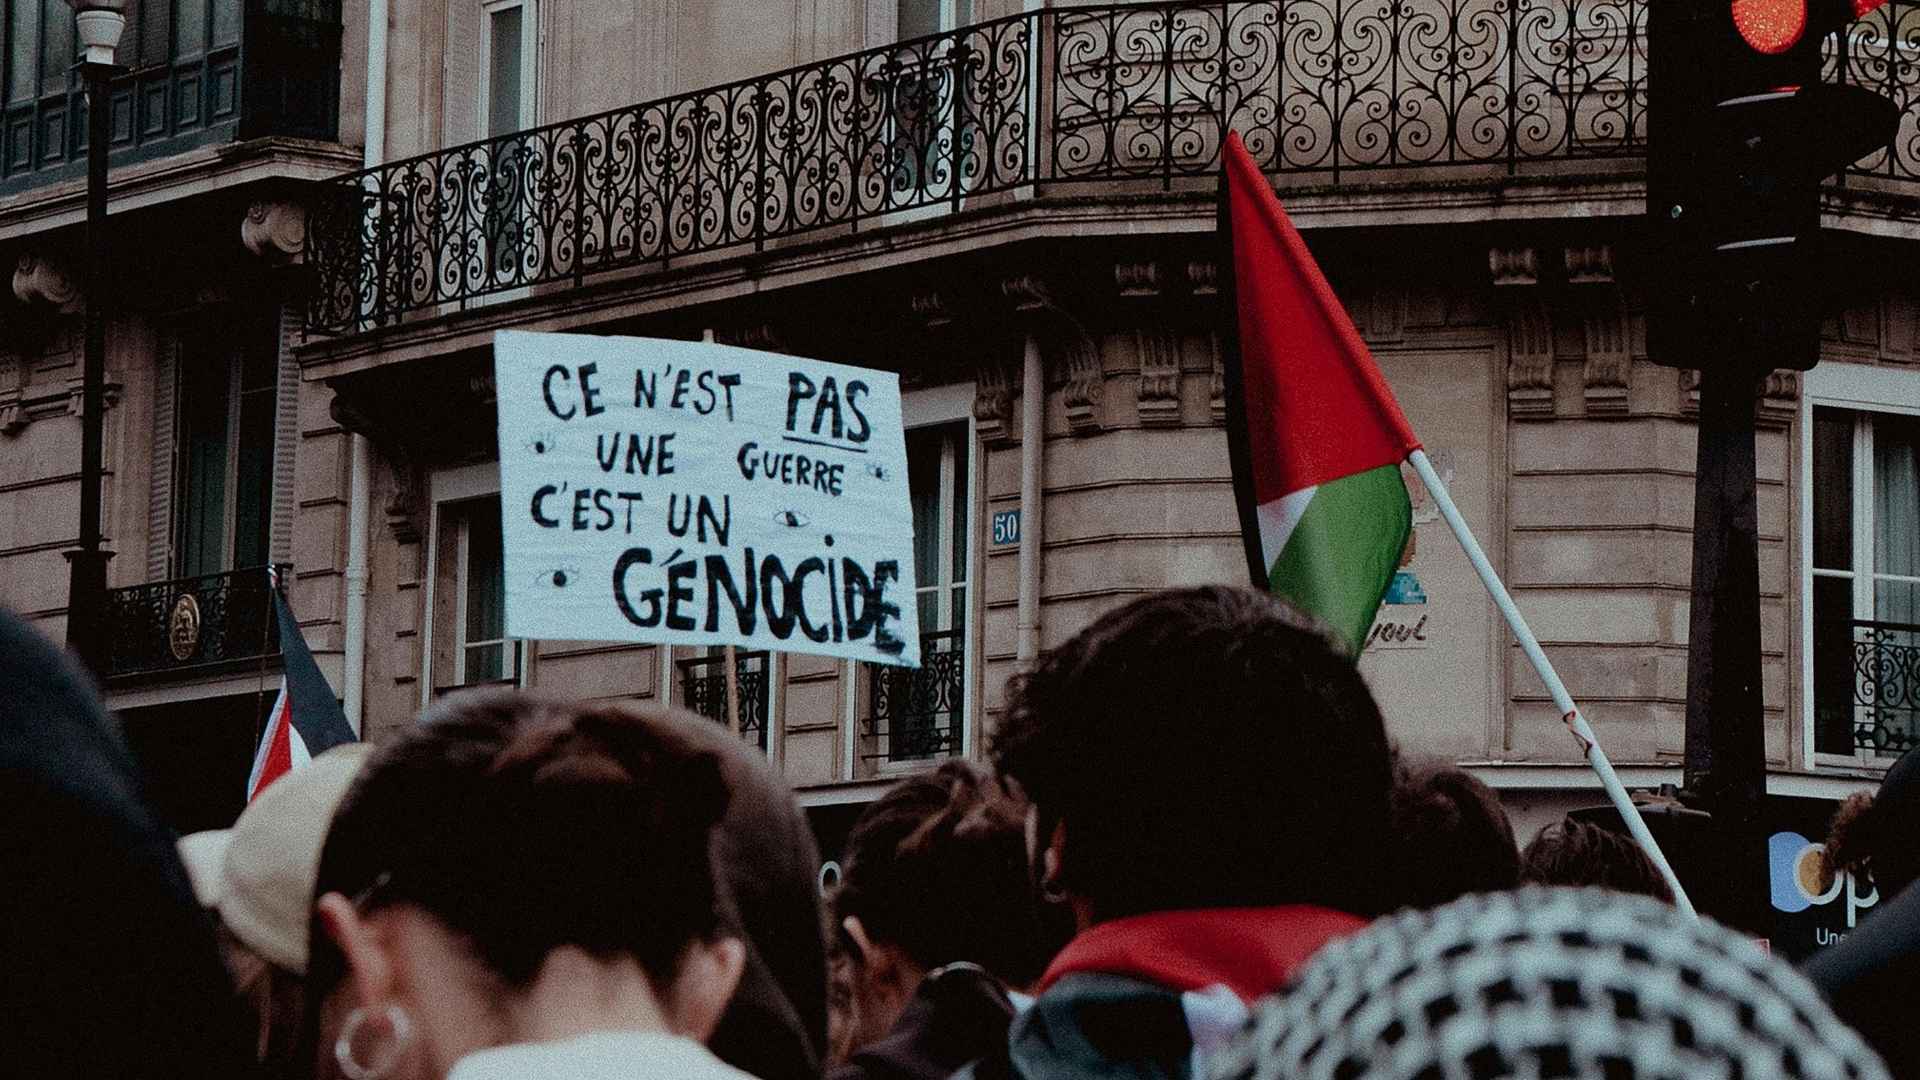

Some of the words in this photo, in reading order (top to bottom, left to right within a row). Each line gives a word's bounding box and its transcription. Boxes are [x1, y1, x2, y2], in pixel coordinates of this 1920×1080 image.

[542, 362, 605, 420] CE
[635, 364, 741, 422] N'EST
[786, 372, 871, 442] PAS
[597, 432, 676, 476] UNE
[737, 442, 844, 496] GUERRE
[530, 481, 643, 534] C'EST
[667, 493, 730, 547] UN
[995, 514, 1017, 542] 50
